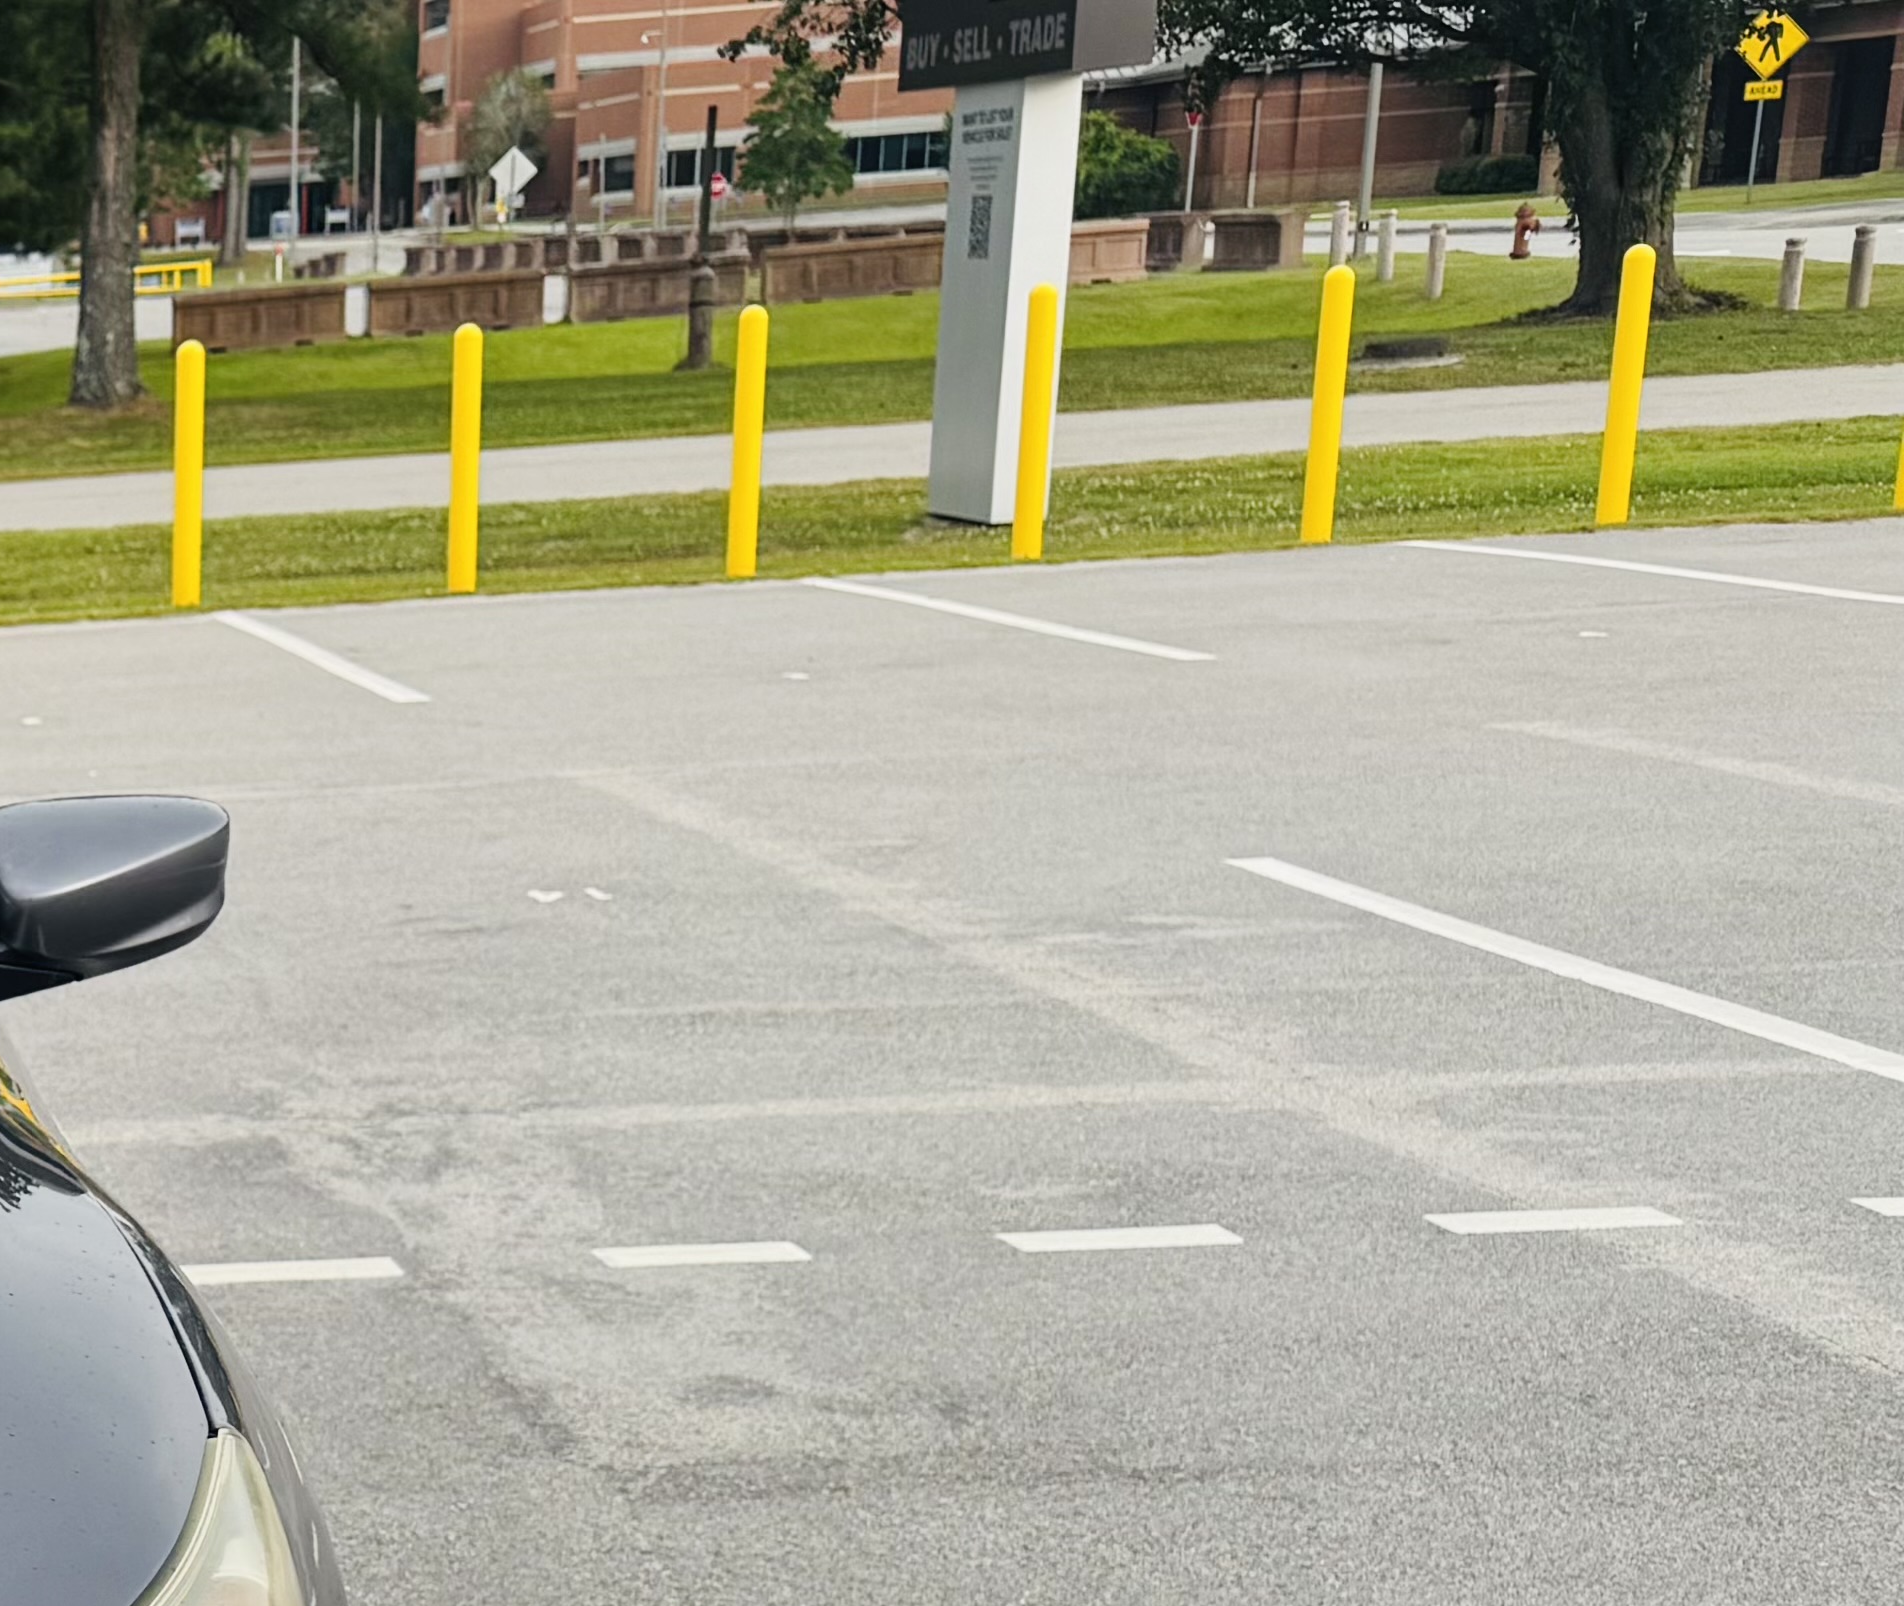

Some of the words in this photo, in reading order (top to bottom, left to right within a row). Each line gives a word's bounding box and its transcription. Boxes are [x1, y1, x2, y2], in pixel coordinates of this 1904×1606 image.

[906, 33, 941, 71] BUY
[953, 25, 991, 65] SELL
[1009, 12, 1067, 57] TRADE
